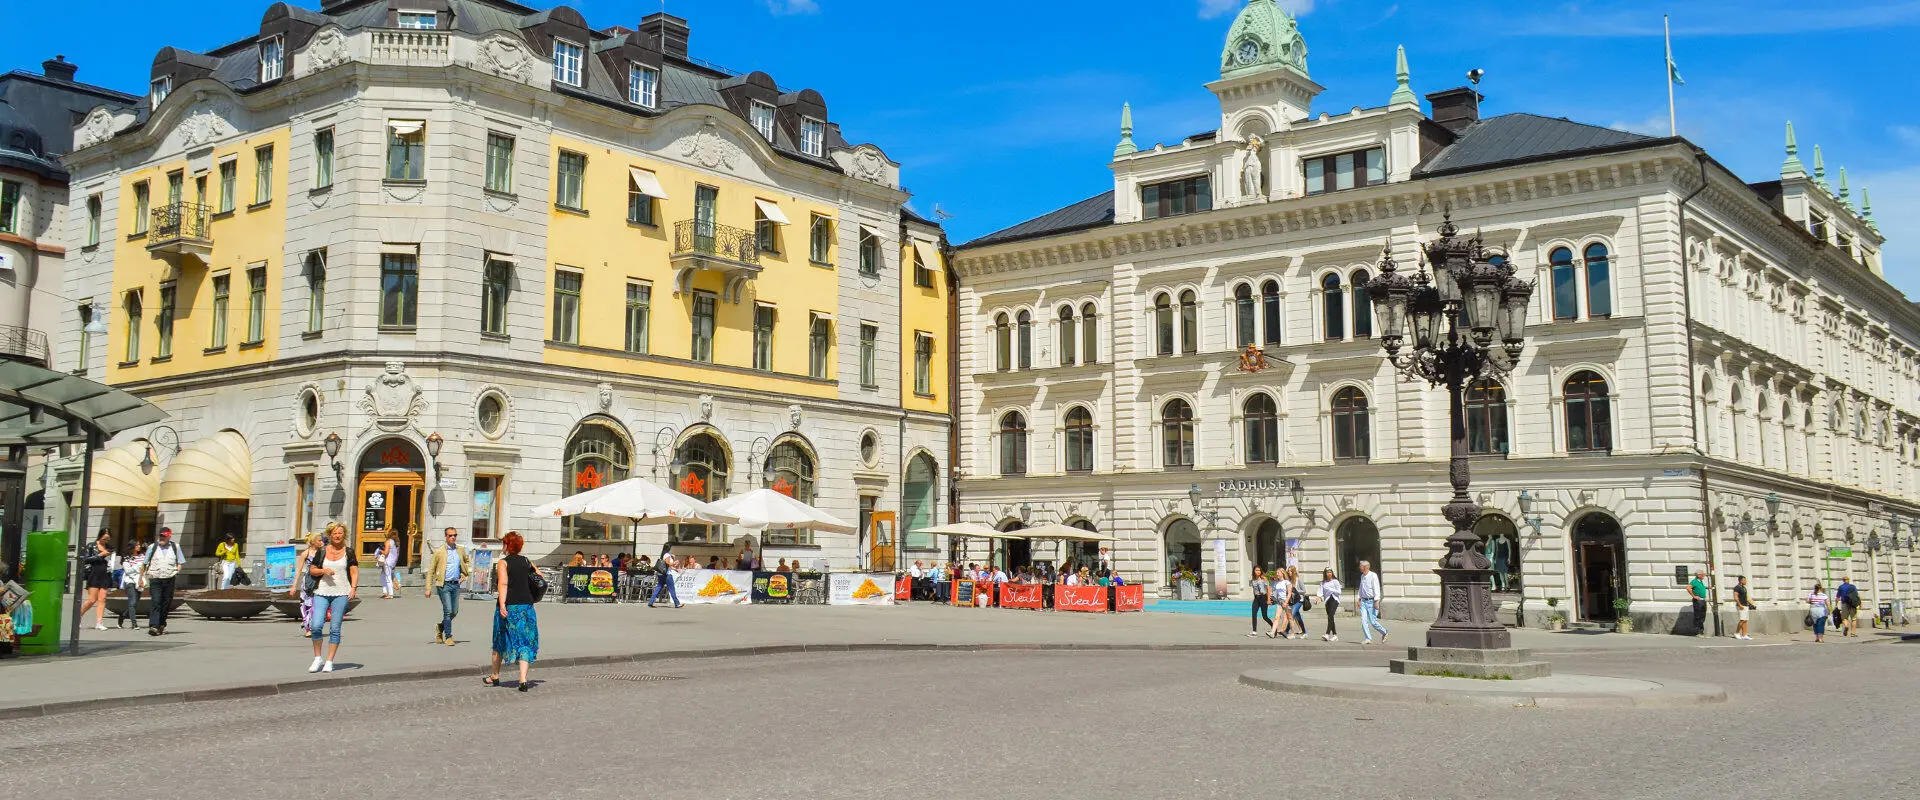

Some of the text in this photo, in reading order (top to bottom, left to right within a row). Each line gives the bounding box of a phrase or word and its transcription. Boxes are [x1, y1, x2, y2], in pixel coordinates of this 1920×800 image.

[381, 445, 410, 465] MAX
[577, 464, 604, 488] MAX
[680, 472, 705, 494] MAX
[1004, 586, 1039, 603] Steak
[1060, 588, 1105, 606] Steak
[1118, 587, 1141, 606] Steak
